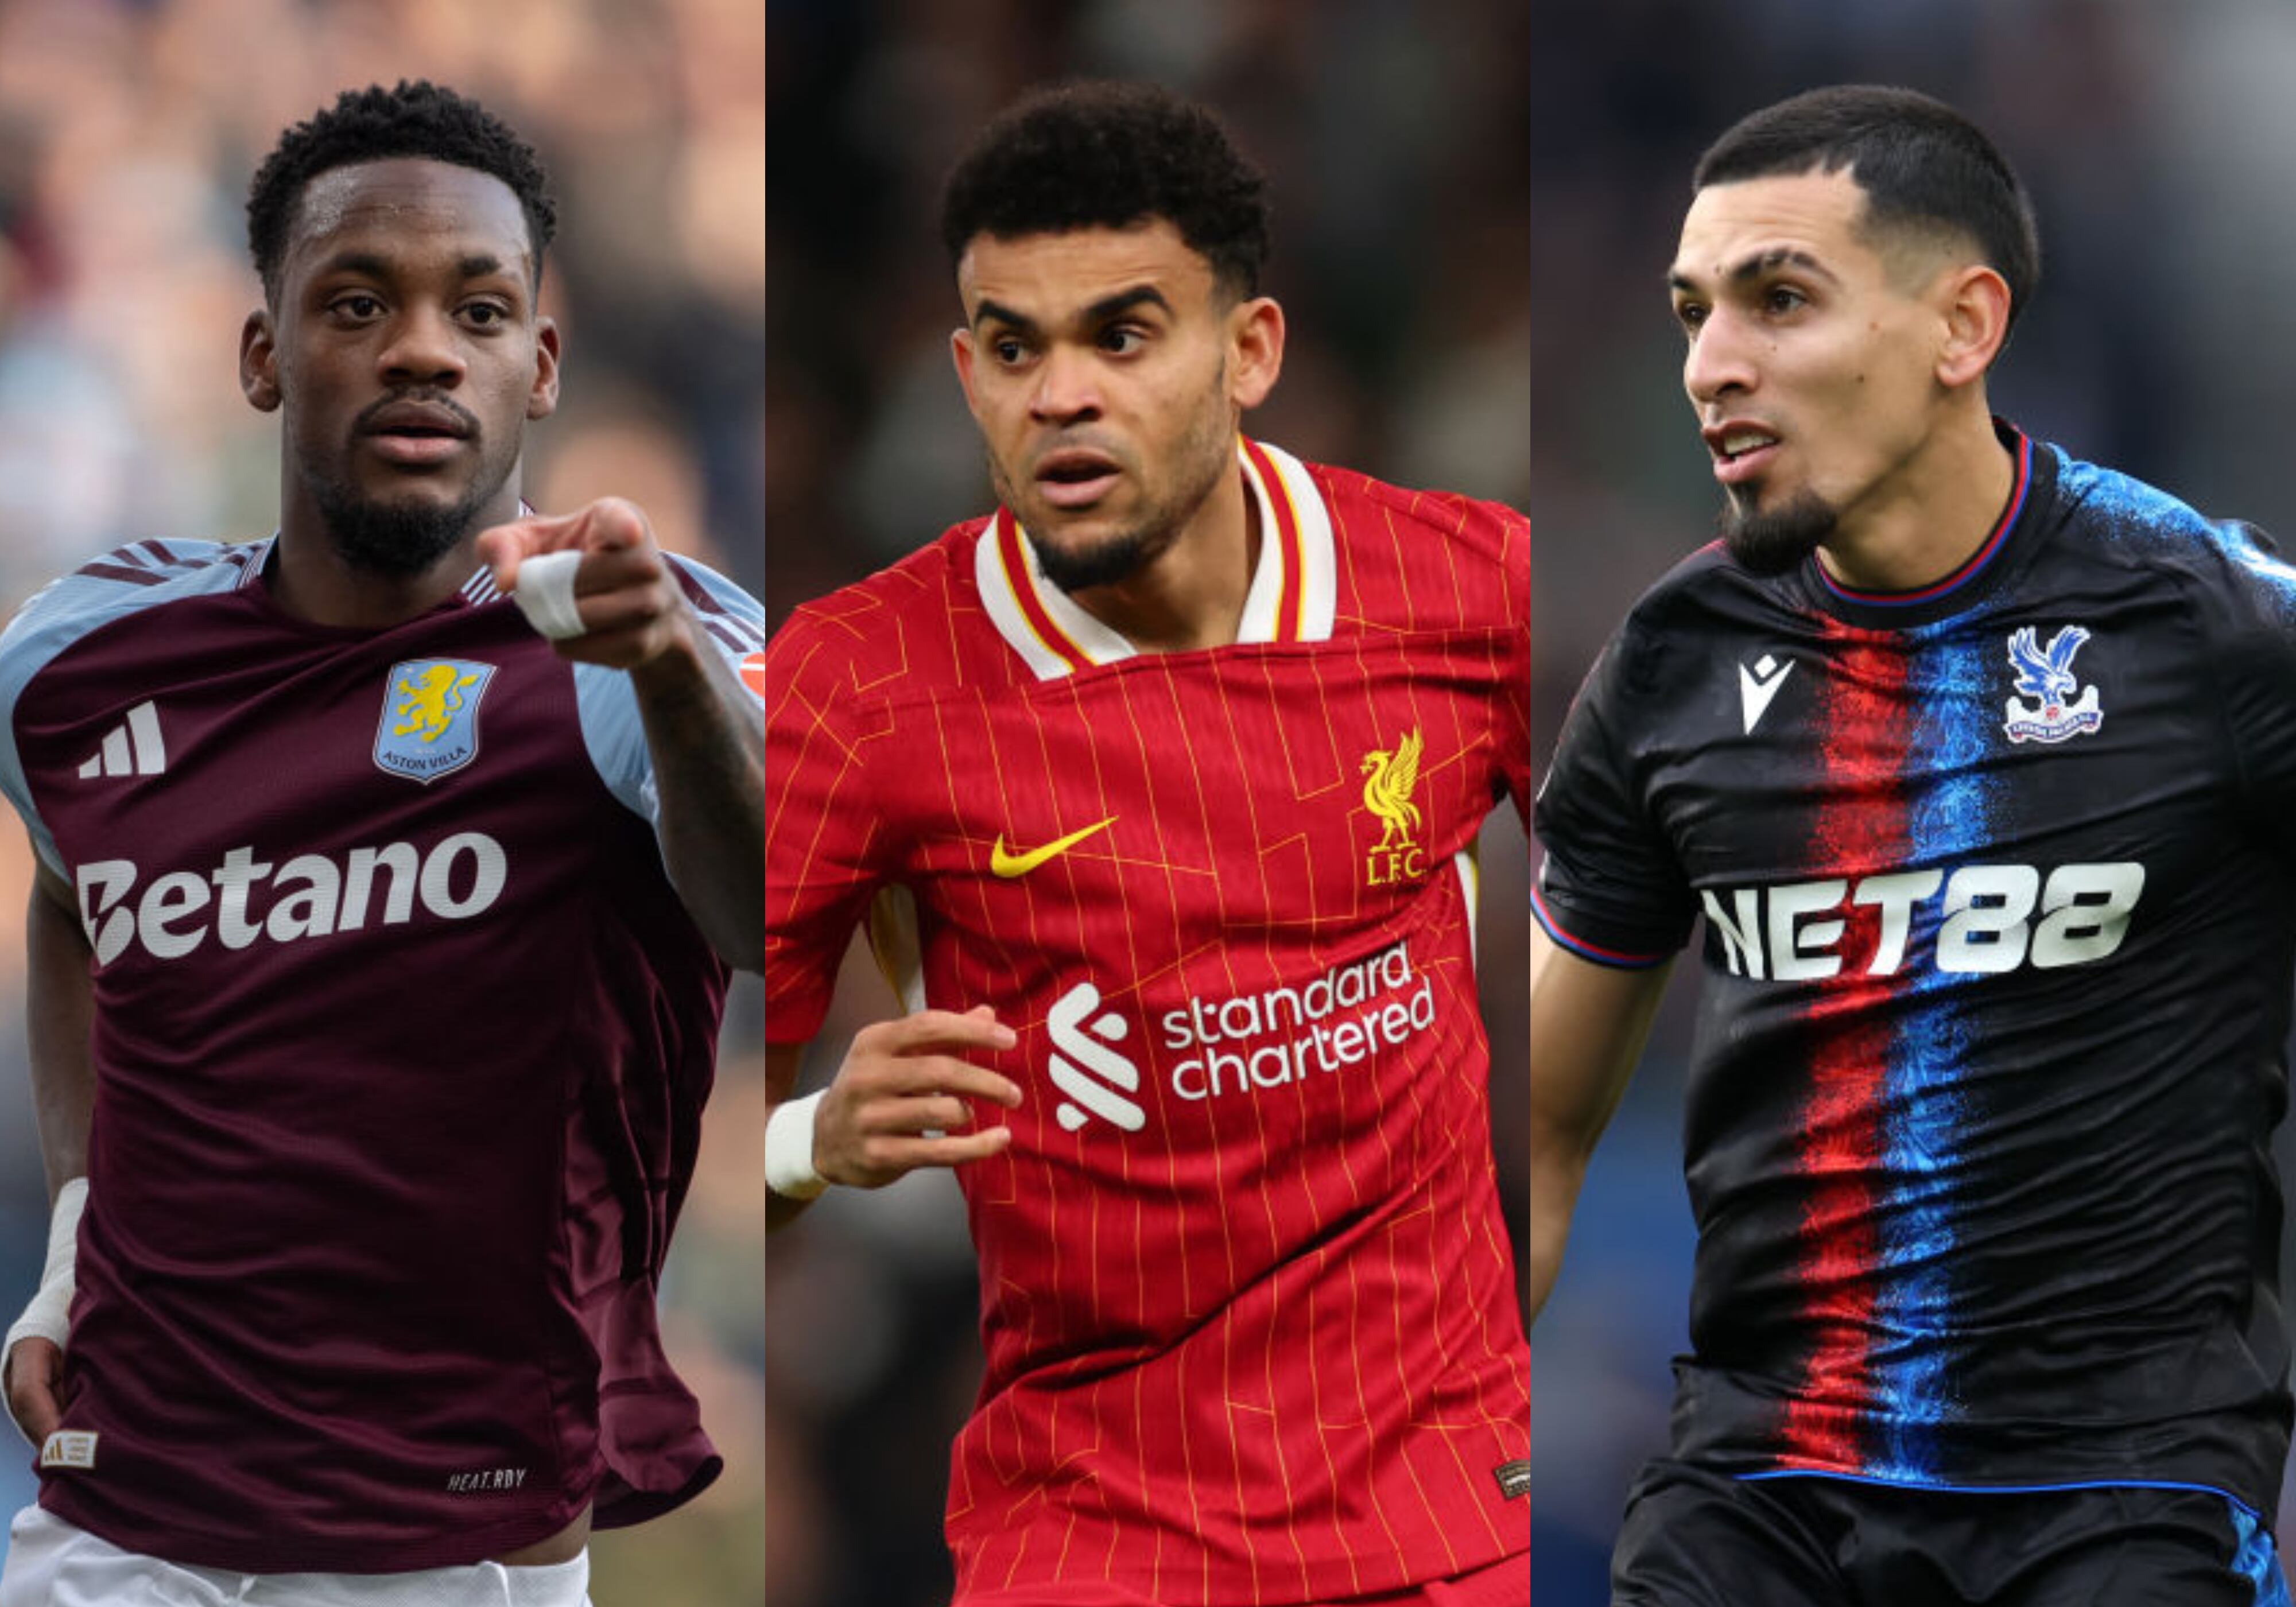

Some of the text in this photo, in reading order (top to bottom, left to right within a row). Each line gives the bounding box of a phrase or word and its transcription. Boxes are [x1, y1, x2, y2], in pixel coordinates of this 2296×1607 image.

[383, 746, 467, 770] ASTON VILLA
[76, 832, 507, 968] Betano
[1699, 861, 2146, 981] NET88
[1162, 940, 1412, 1049] standard
[1171, 976, 1435, 1100] chartered
